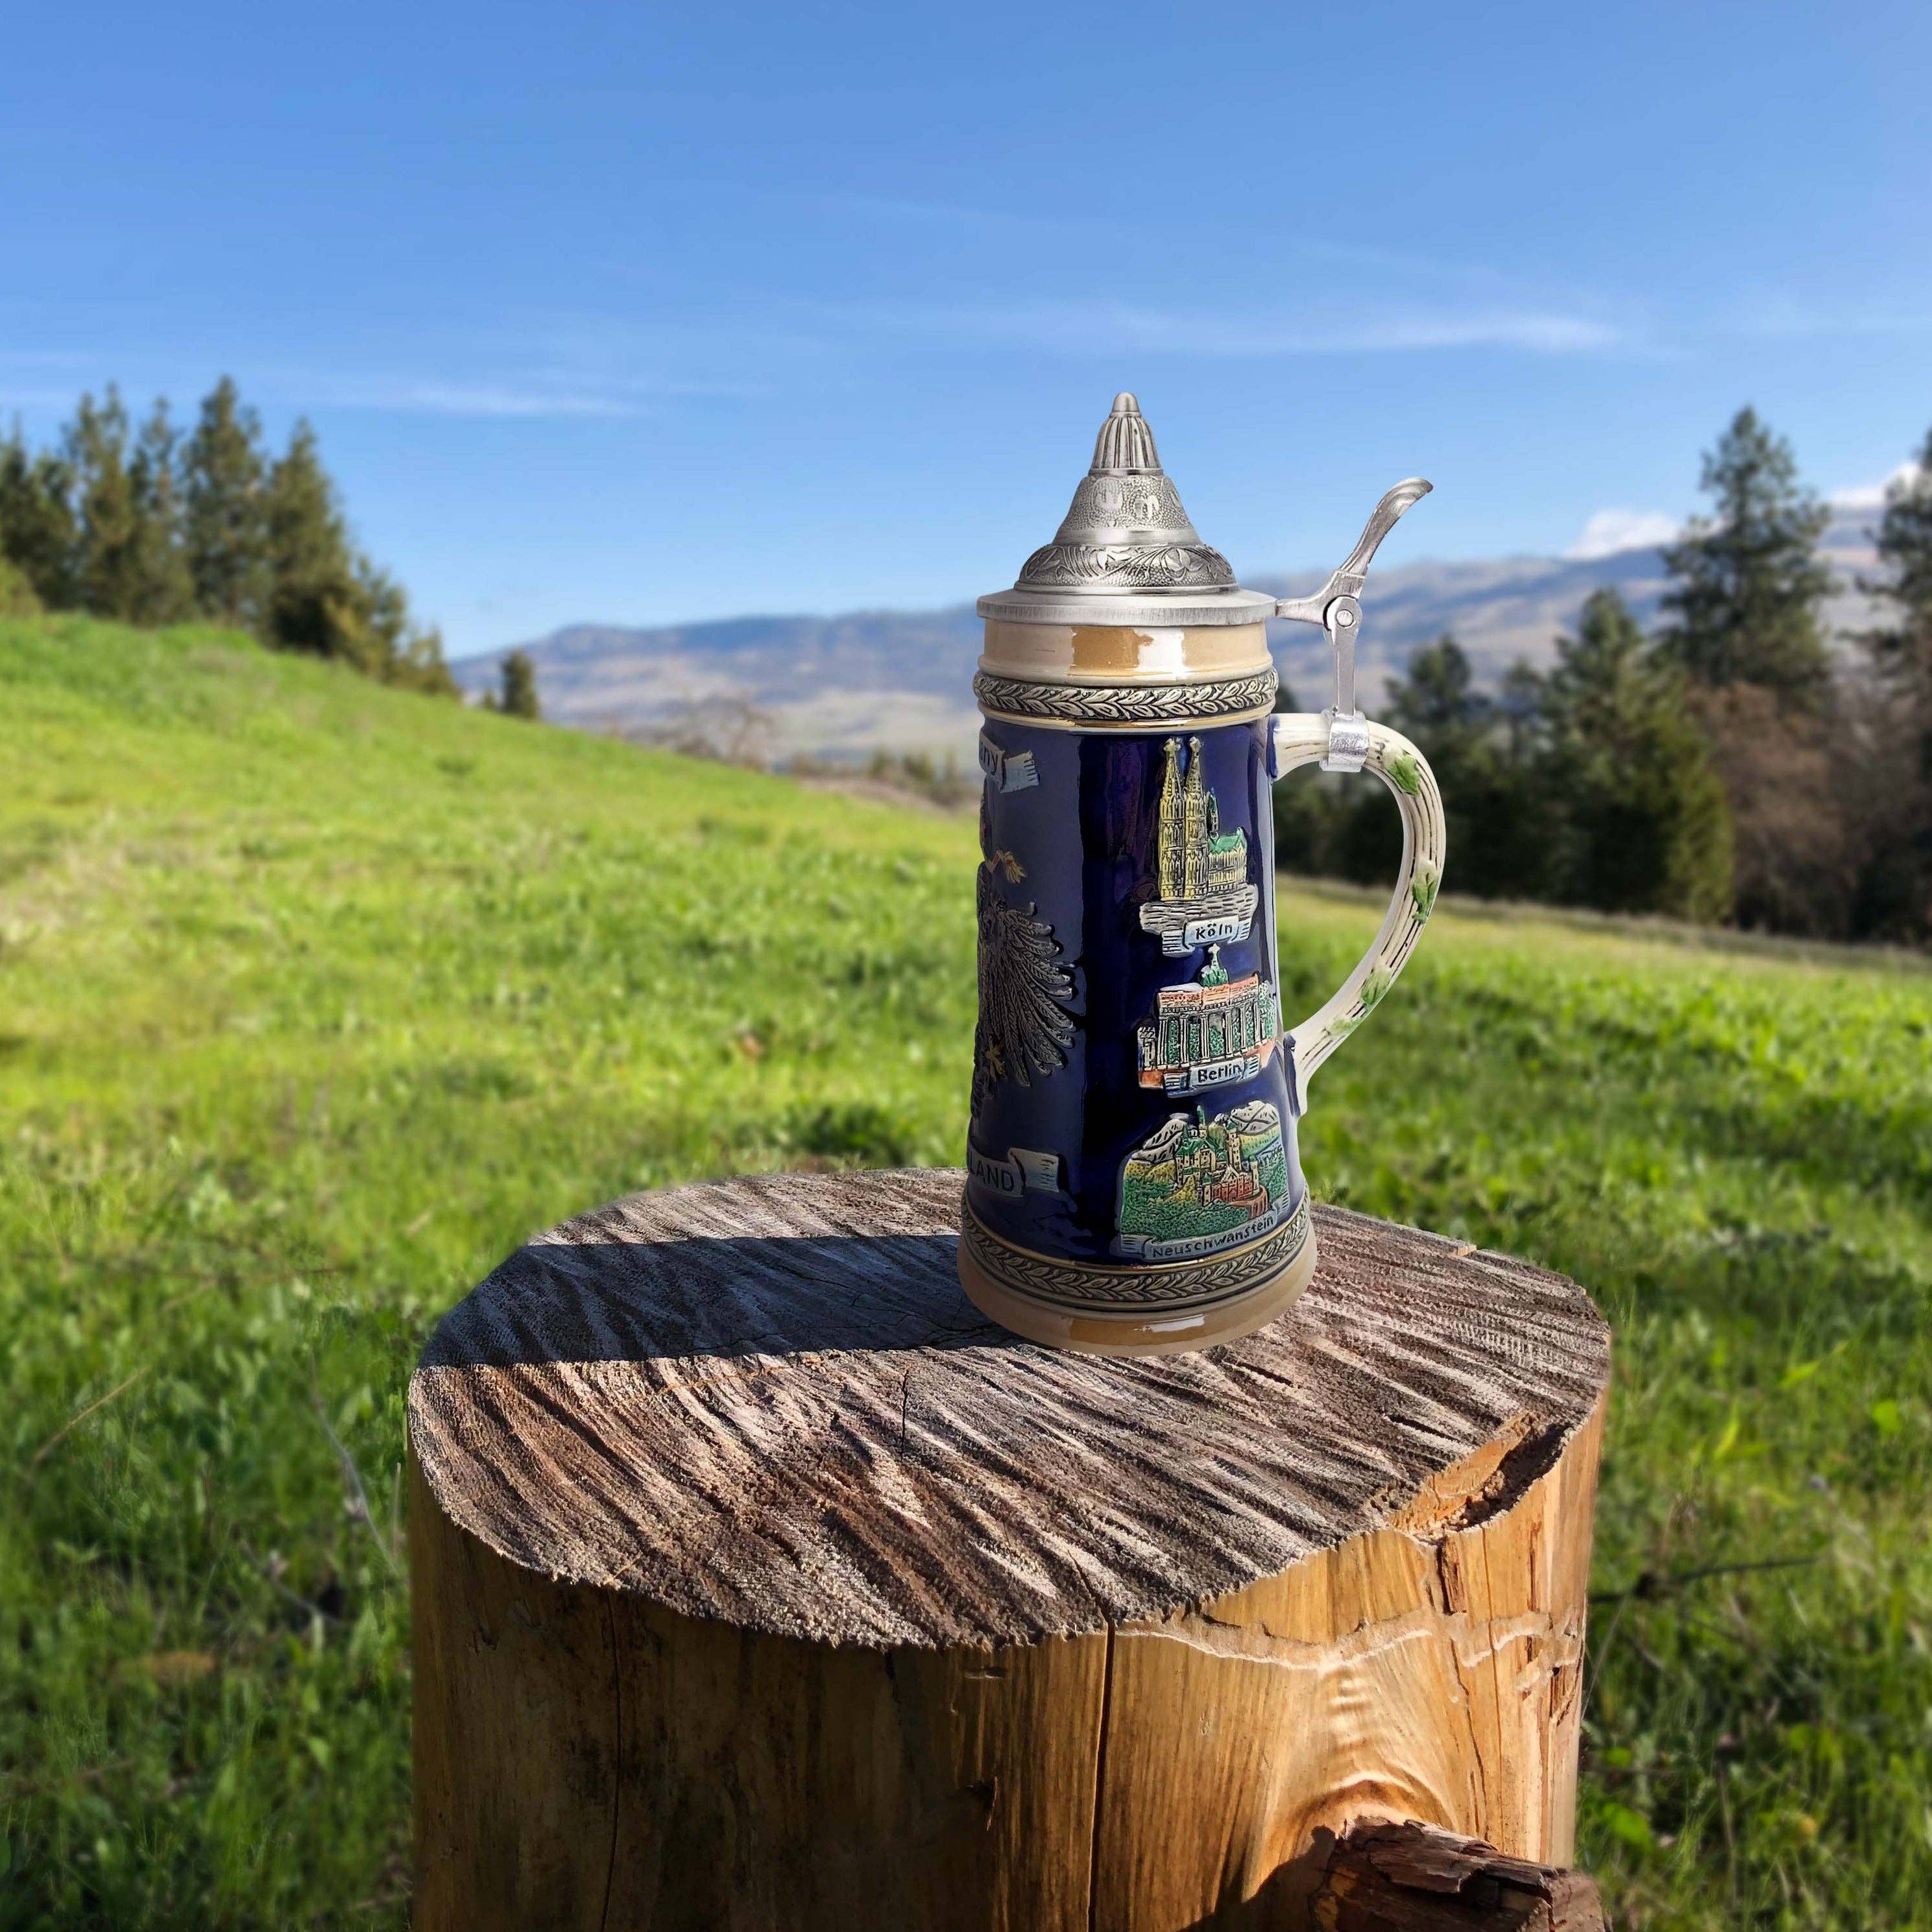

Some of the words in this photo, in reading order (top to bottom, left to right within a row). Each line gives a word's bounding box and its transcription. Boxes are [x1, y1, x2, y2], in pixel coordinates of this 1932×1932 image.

[1196, 923, 1232, 939] Köln
[1198, 1064, 1242, 1083] Berlin
[1153, 1216, 1274, 1257] Neuschwanstein
